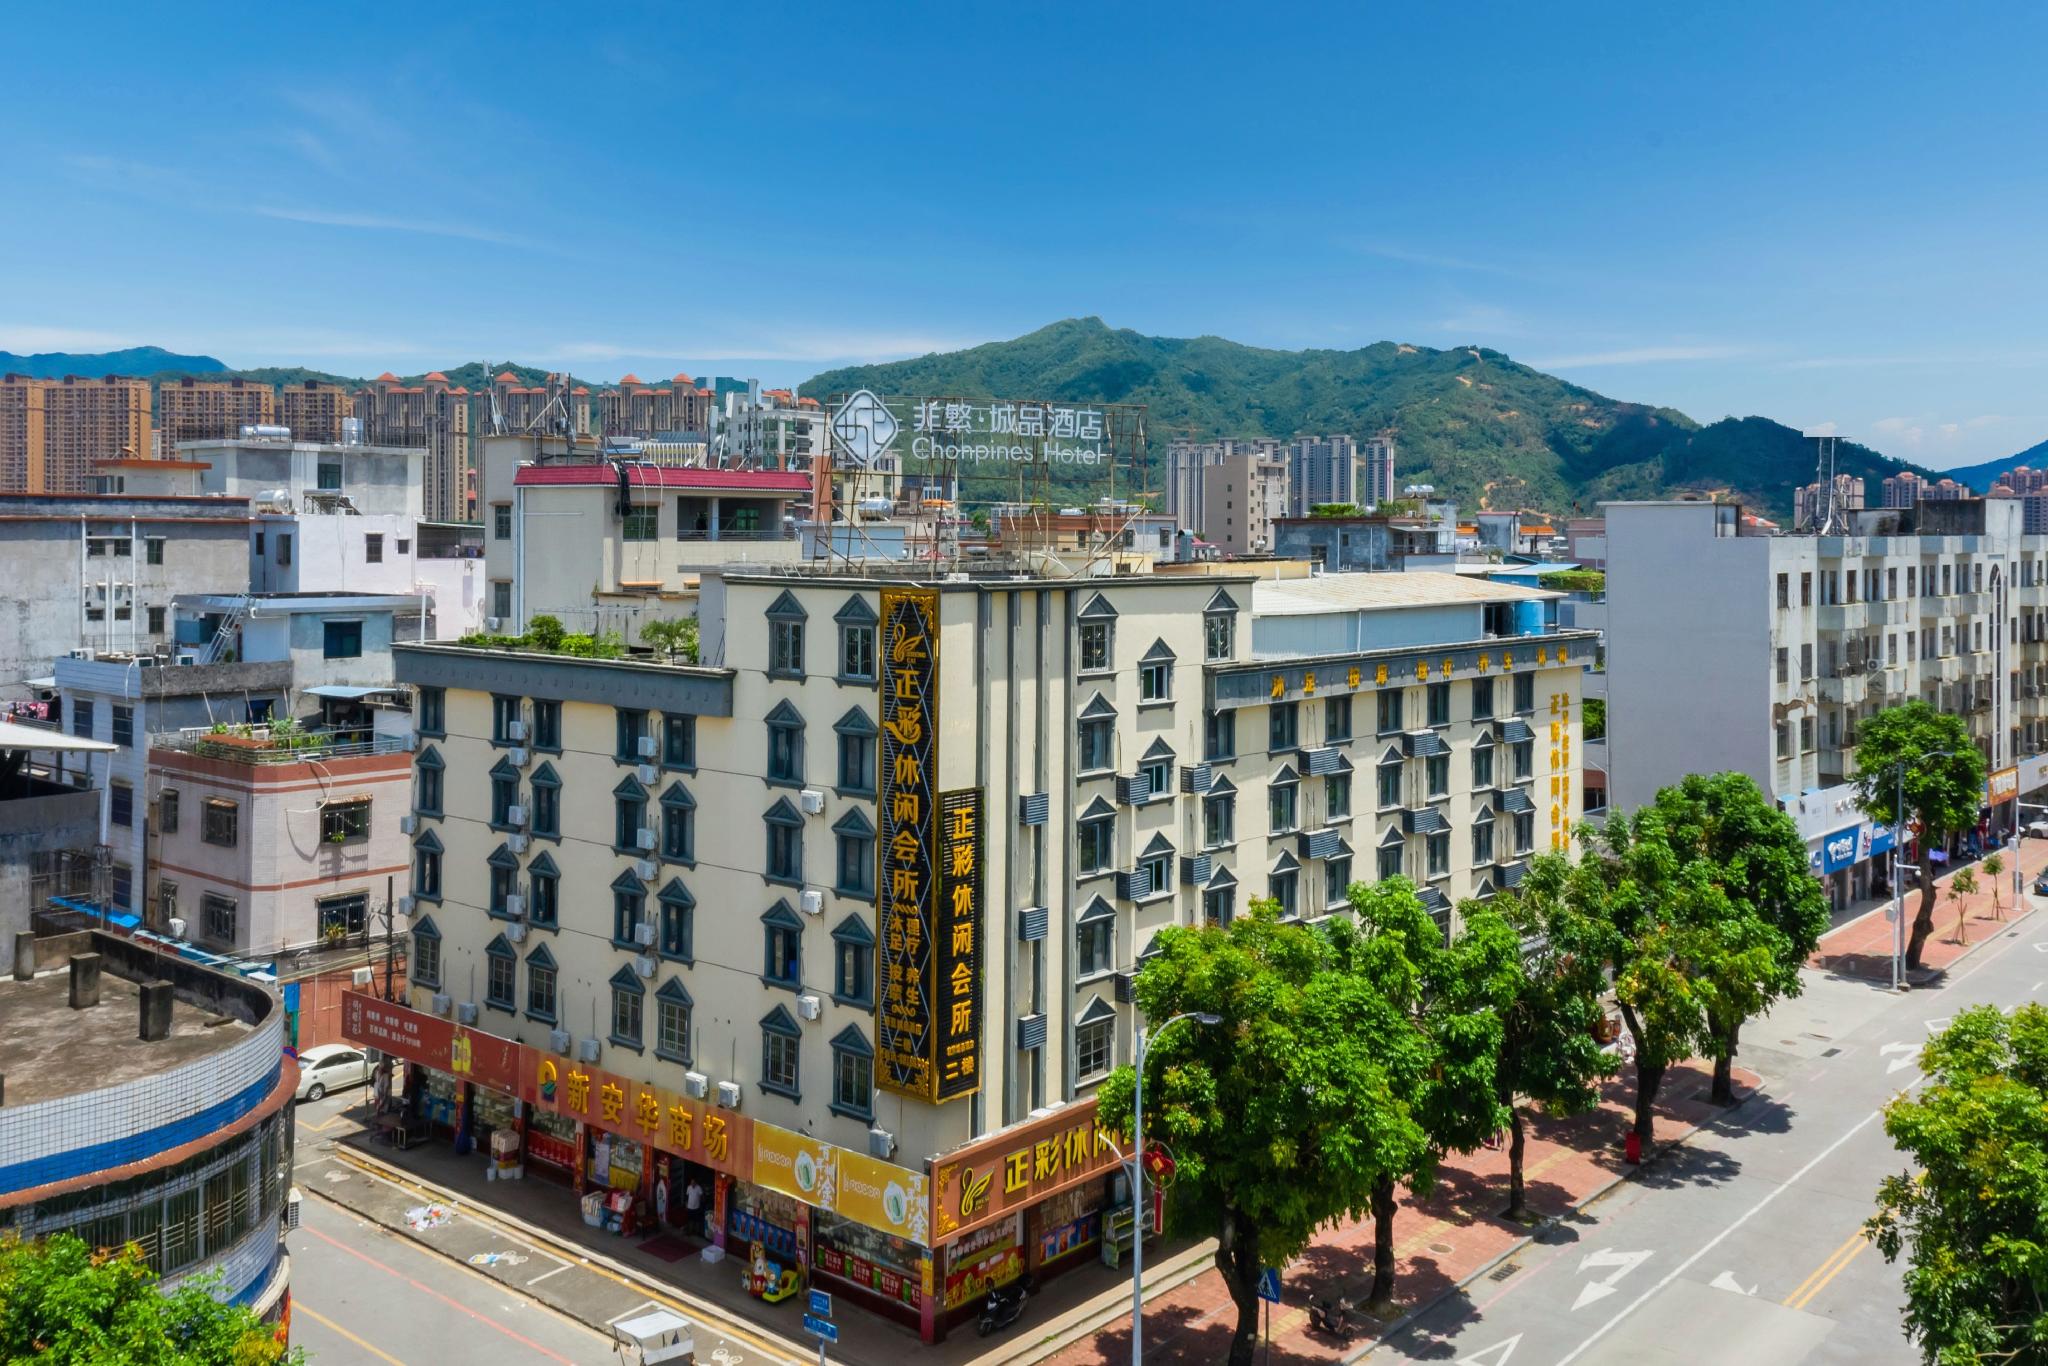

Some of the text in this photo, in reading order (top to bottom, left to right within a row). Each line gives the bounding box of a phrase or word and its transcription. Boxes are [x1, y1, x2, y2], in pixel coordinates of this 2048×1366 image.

[911, 436, 1101, 466] Chonpines Hotel
[883, 669, 922, 900] 正彩休闲会所
[951, 807, 973, 1036] 正彩休闲会所
[946, 1055, 975, 1080] 二楼
[567, 1069, 728, 1161] 新安华商场
[1004, 1115, 1132, 1194] 正彩休闲
